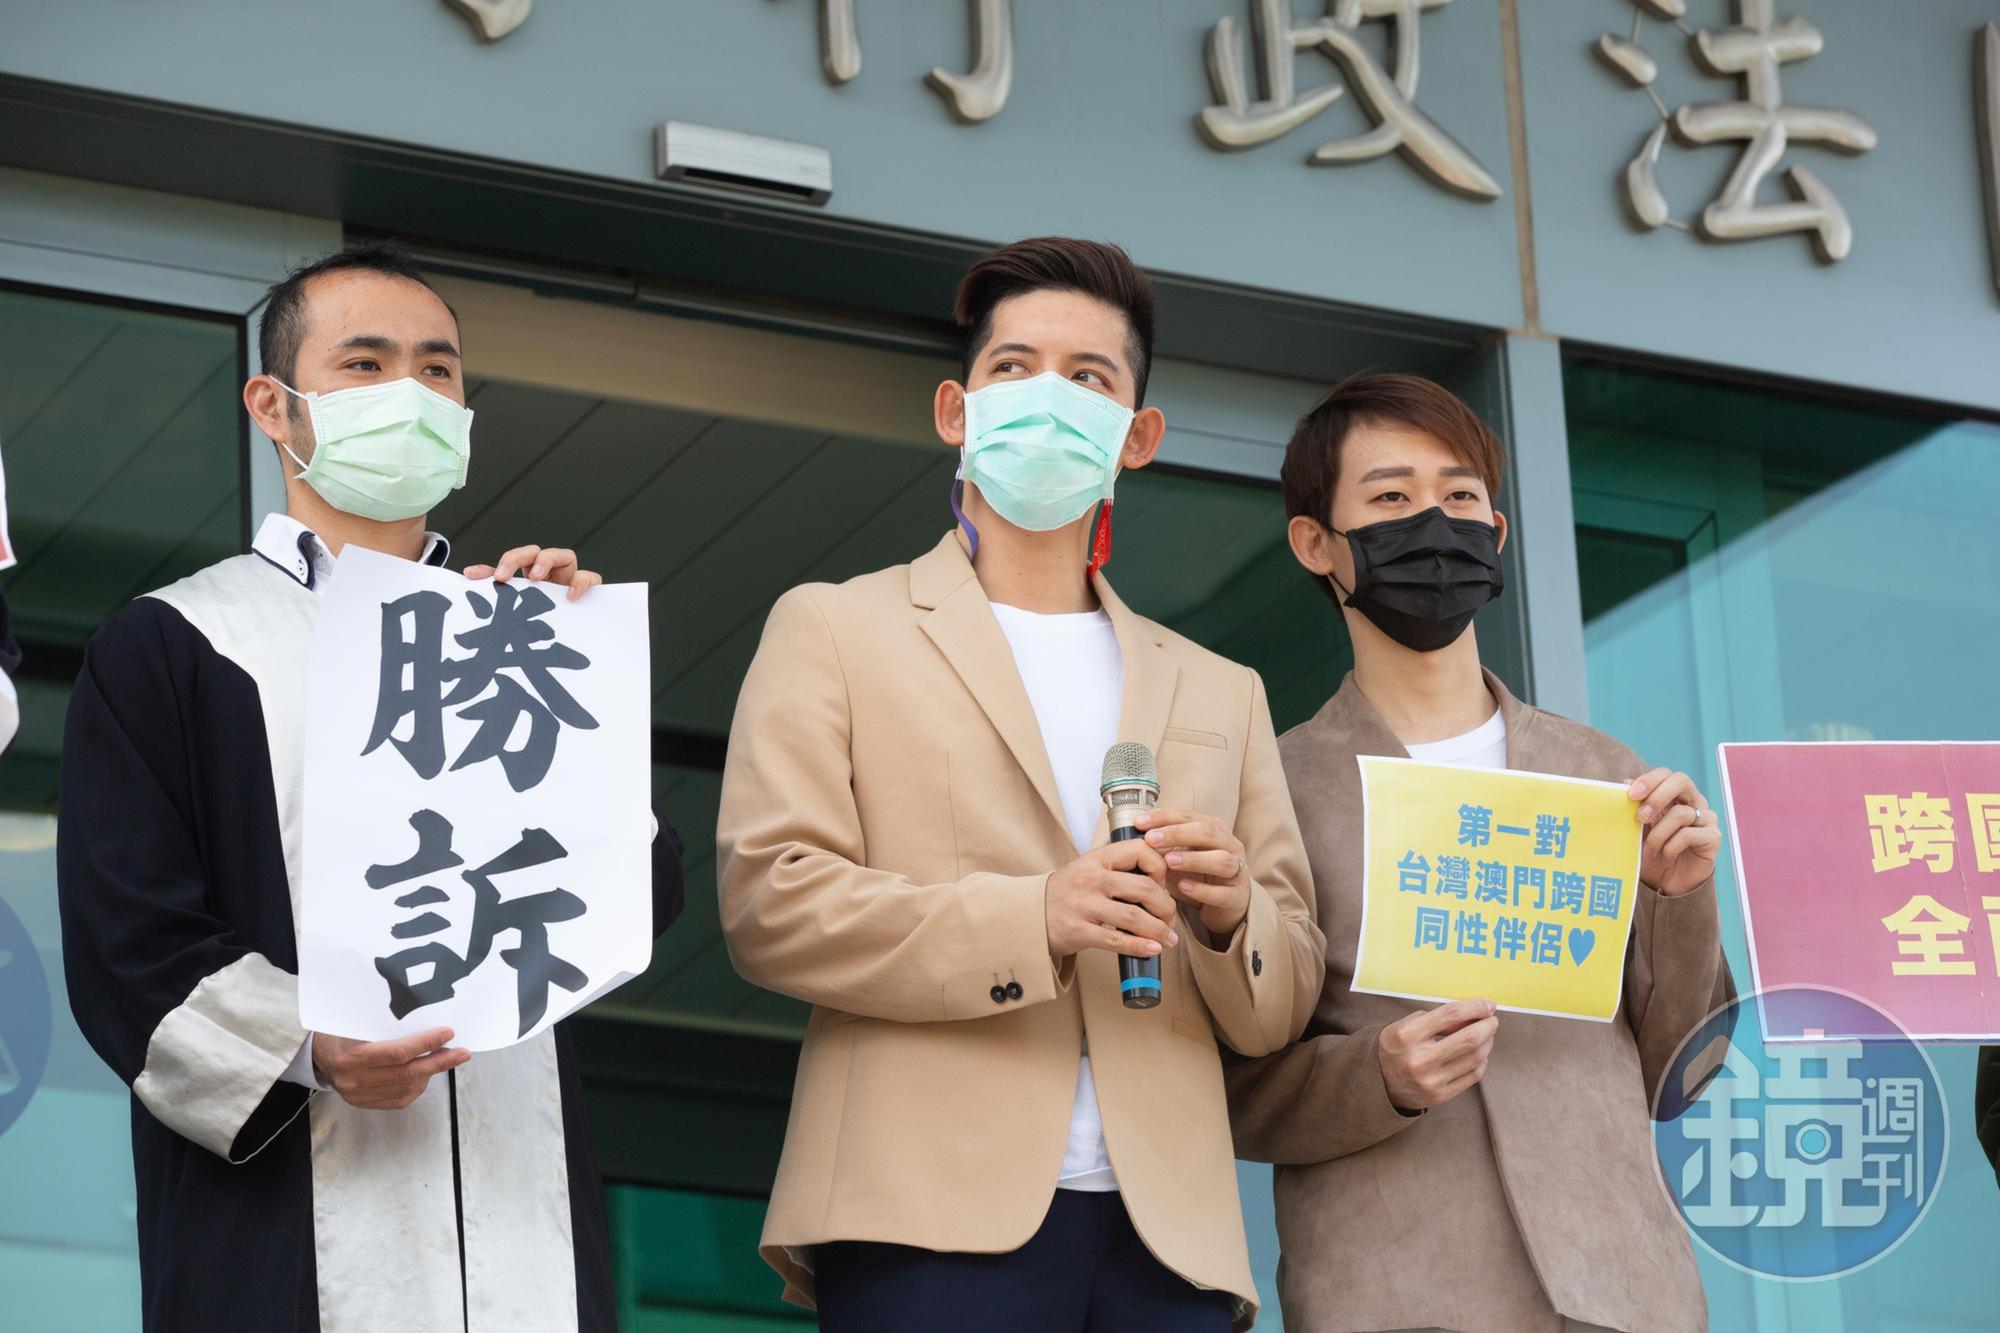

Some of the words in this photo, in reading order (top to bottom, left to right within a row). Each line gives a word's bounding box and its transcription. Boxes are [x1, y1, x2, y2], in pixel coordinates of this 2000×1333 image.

[360, 581, 600, 1038] 勝訴
[1457, 803, 1571, 859] 第一對
[1397, 850, 1623, 920] 台灣澳門跨國
[1414, 906, 1564, 966] 同性伴侶
[1881, 895, 2000, 977] 全
